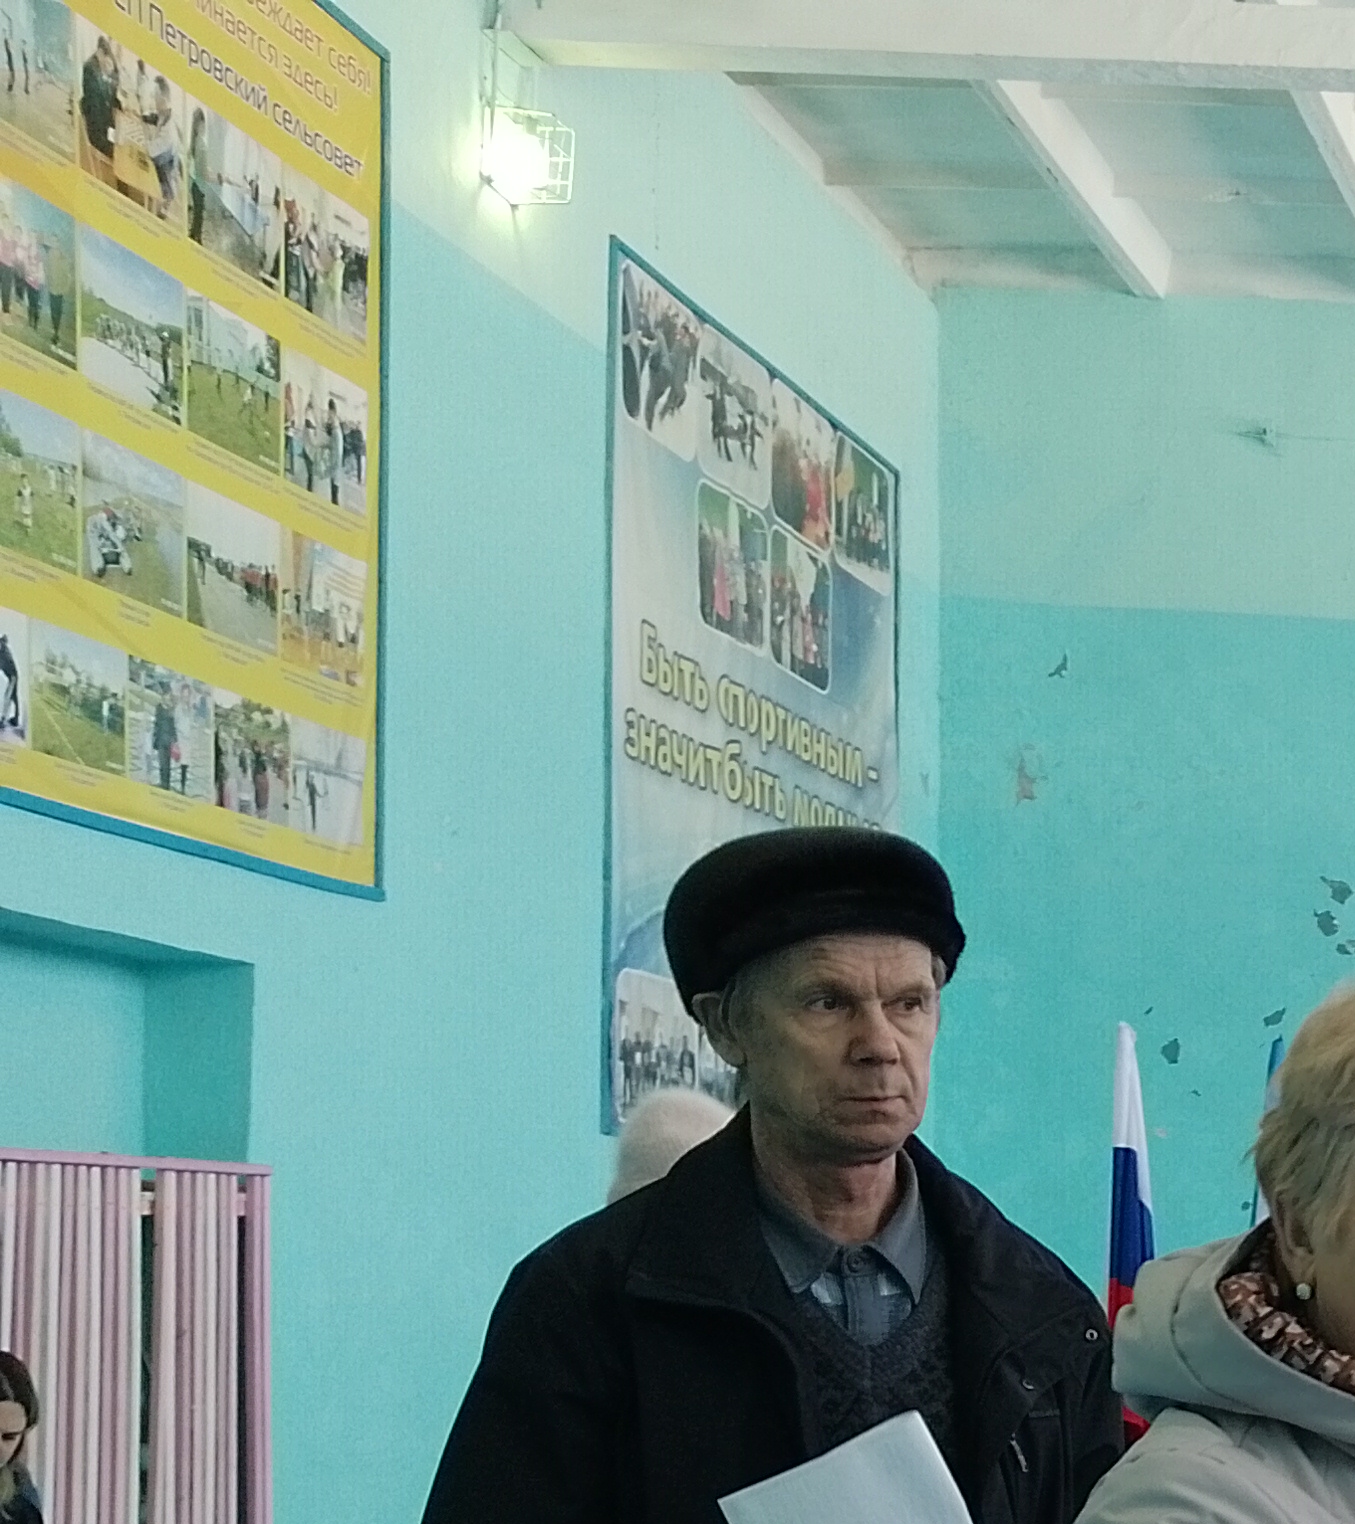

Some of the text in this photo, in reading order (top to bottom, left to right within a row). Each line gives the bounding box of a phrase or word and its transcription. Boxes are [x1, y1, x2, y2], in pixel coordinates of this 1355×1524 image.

[149, 3, 269, 116] Петровский
[273, 102, 364, 180] сельсовет
[196, 0, 338, 112] инается здесь!
[248, 0, 371, 94] еждает себя!
[640, 618, 710, 713] Быть
